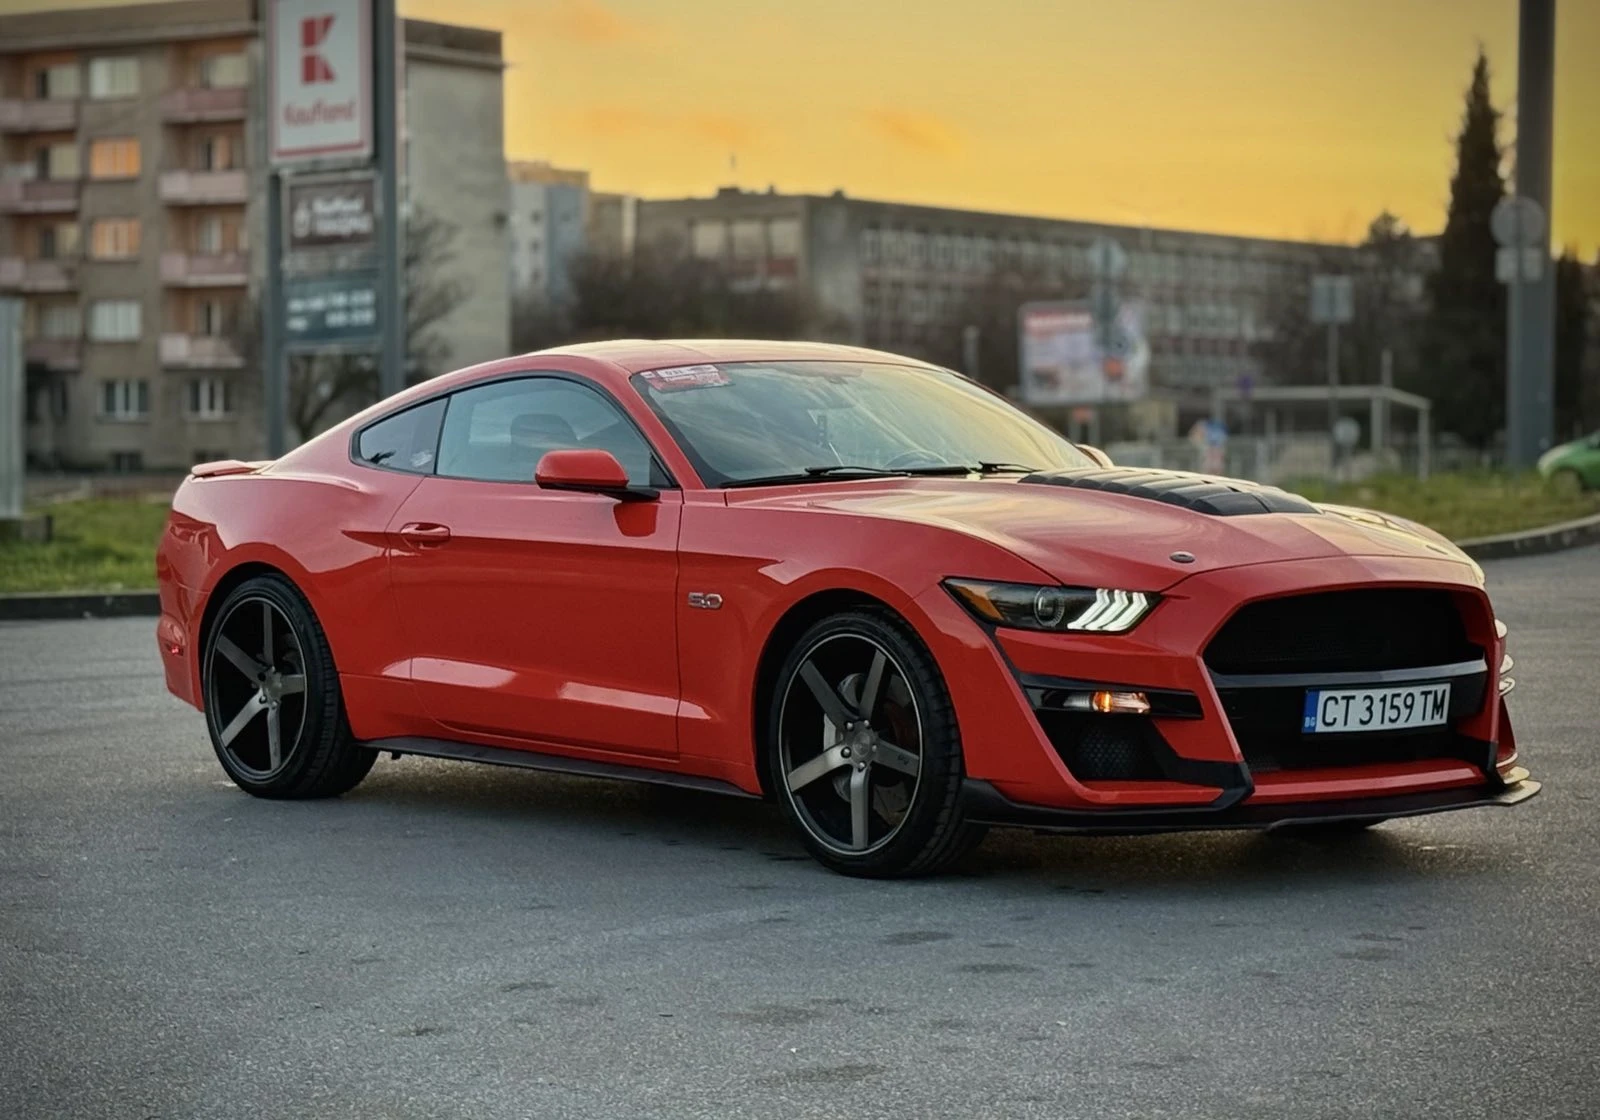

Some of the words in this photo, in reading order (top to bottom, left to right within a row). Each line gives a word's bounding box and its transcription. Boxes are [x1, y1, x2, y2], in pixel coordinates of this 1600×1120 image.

[301, 14, 336, 84] K
[283, 99, 356, 127] Kaufland
[1321, 695, 1356, 727] CT
[1359, 692, 1415, 726] 3159
[1420, 689, 1447, 721] TM
